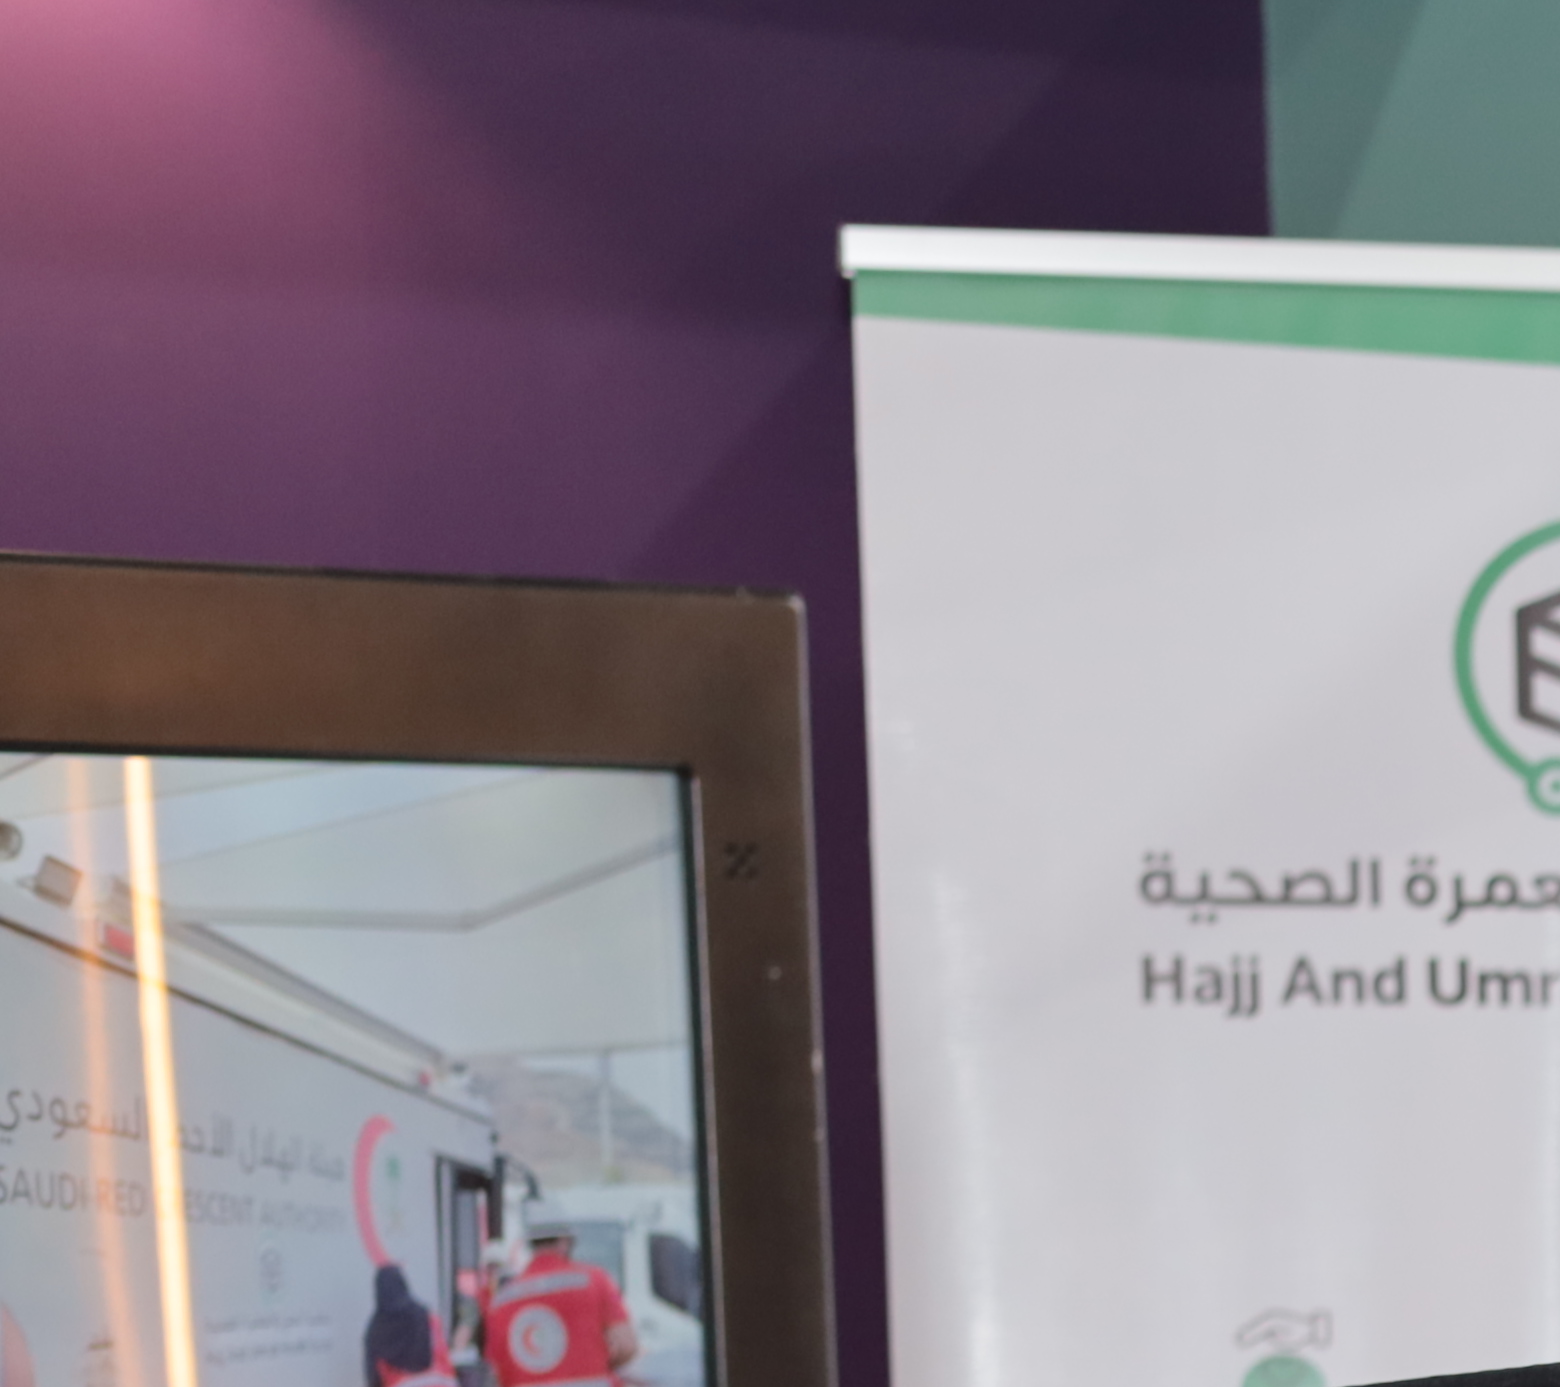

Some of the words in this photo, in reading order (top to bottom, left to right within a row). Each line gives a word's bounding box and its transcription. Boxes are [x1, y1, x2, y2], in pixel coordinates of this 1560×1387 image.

[1140, 850, 1381, 924] الصحية
[1141, 954, 1261, 1017] Hajj
[1283, 955, 1405, 1006] And
[95, 1176, 147, 1218] RED
